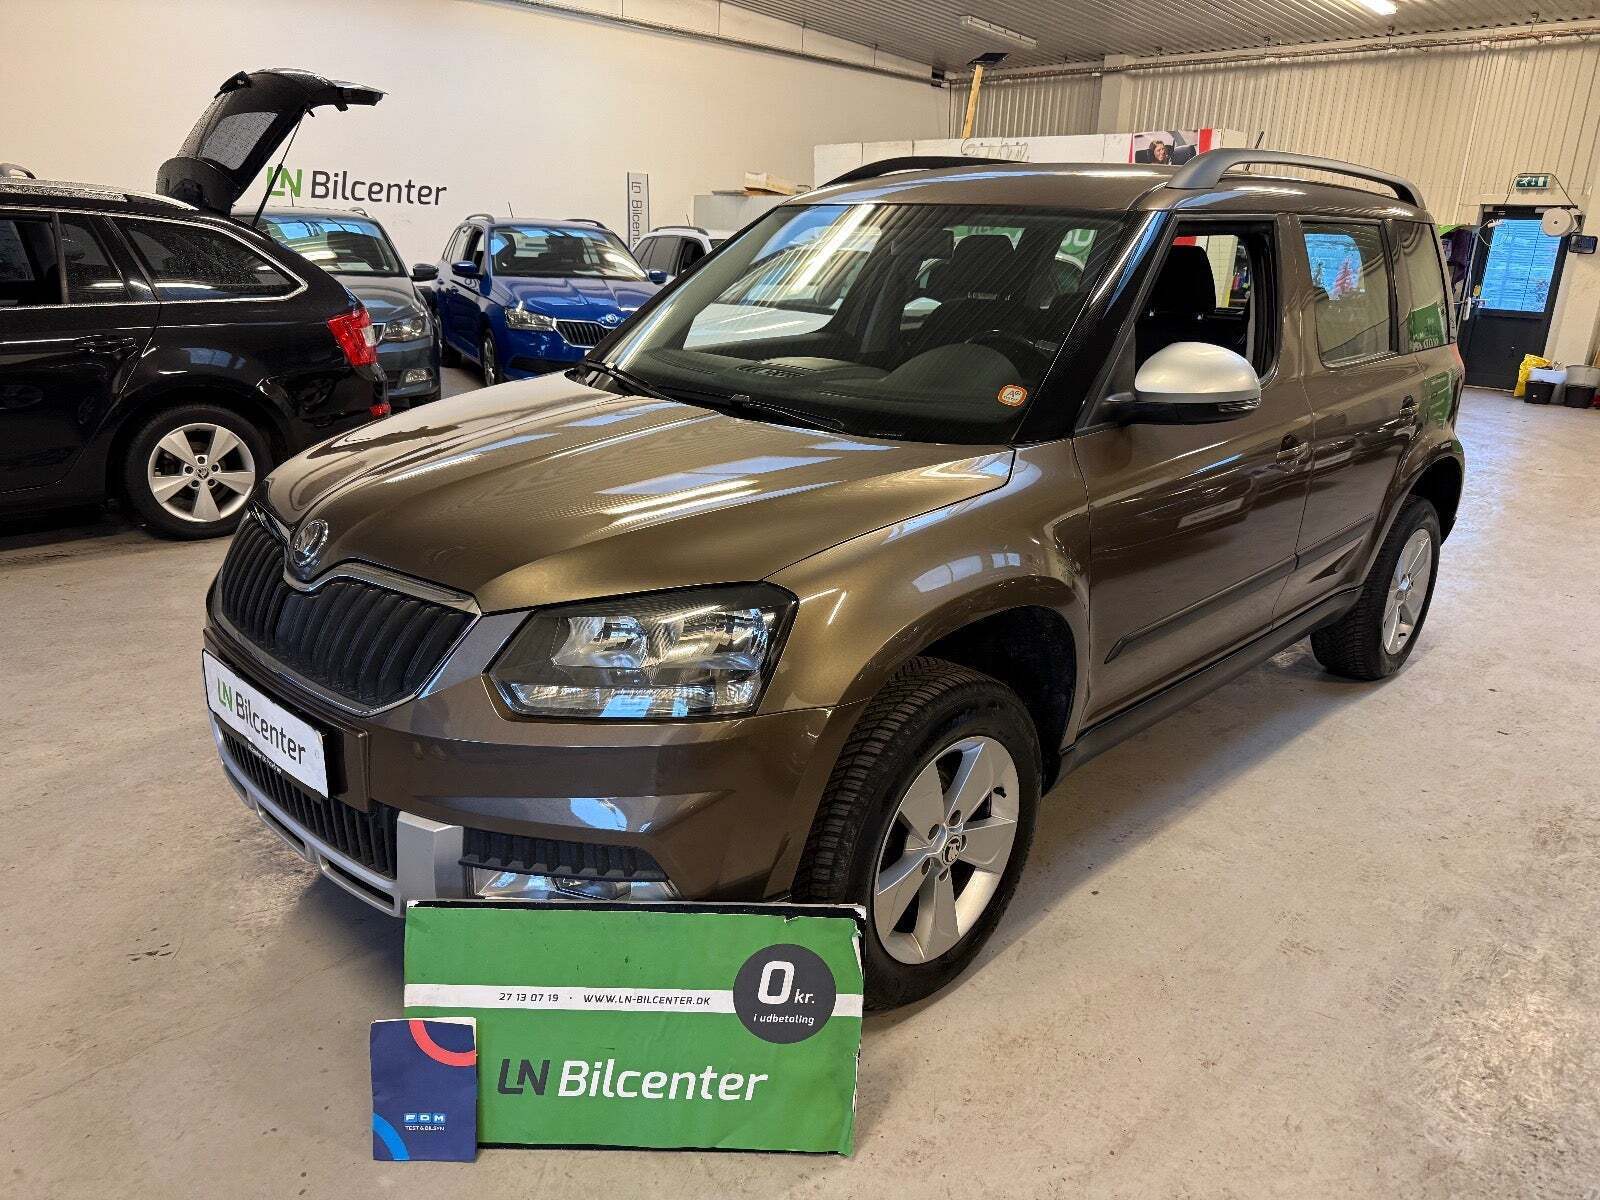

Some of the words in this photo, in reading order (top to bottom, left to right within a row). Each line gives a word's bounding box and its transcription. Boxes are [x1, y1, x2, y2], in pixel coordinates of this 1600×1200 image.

[266, 166, 303, 198] LN
[310, 170, 448, 206] Bilcenter
[631, 199, 643, 247] Bilcent
[217, 677, 233, 712] LN
[235, 690, 306, 765] Bilcenter
[498, 992, 512, 1001] 27
[516, 993, 527, 1002] 13
[530, 993, 544, 1002] 07
[548, 993, 559, 1002] 19
[583, 993, 711, 1006] WWW.LN-BILCENTER.DK
[757, 960, 795, 1005] 0
[794, 988, 815, 1004] kr.
[753, 1013, 758, 1023] i
[759, 1013, 815, 1026] udbetaling
[497, 1058, 551, 1096] LN
[557, 1058, 769, 1101] Bilcenter
[404, 1113, 446, 1122] FDM
